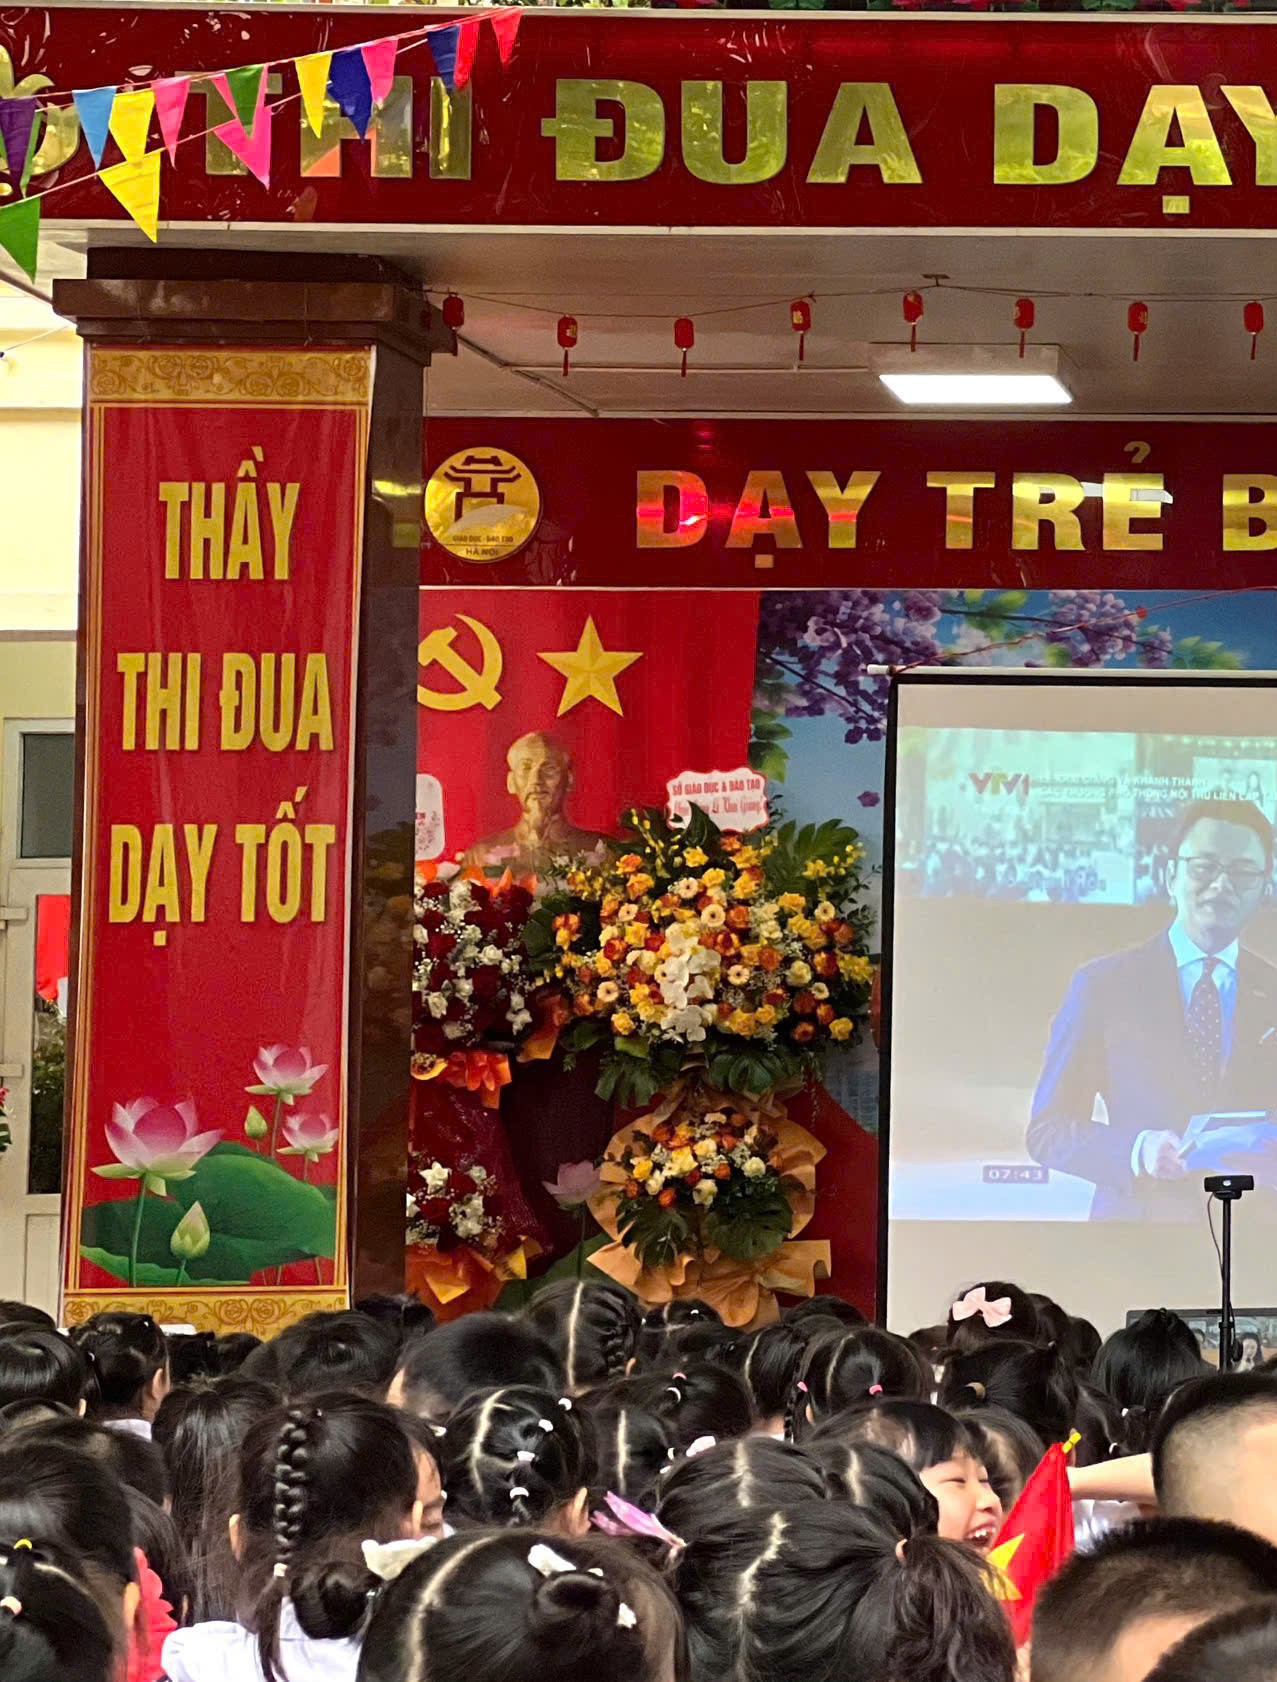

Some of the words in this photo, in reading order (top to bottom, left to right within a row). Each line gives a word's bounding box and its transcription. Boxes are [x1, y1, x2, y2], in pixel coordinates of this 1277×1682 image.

[540, 78, 923, 185] ĐUA
[159, 446, 301, 580] THẦY
[636, 470, 882, 568] DẠY
[927, 441, 1165, 551] TRẺ
[116, 652, 202, 751] THI
[219, 652, 335, 753] ĐUA
[108, 823, 219, 947] DẠY
[235, 786, 336, 924] TỐT
